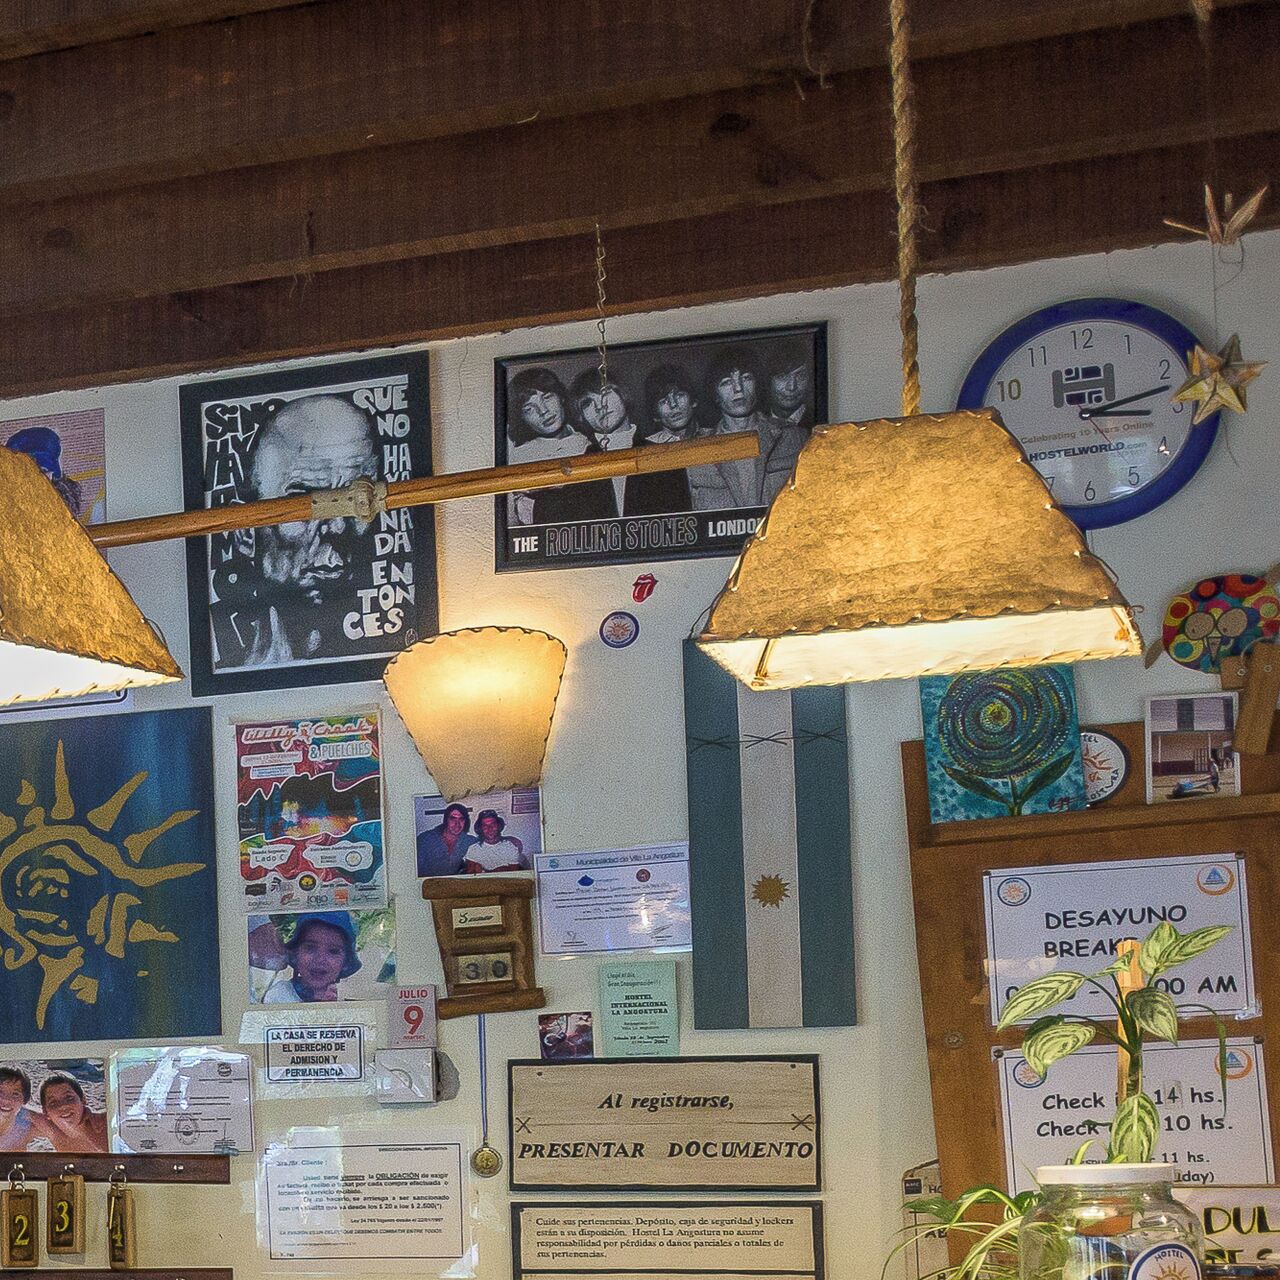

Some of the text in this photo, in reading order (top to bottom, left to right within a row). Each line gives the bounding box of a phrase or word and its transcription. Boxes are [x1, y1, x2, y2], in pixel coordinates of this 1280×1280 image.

[1071, 328, 1093, 349] 12
[1124, 335, 1131, 354] 1
[1028, 346, 1047, 367] 11
[1159, 359, 1170, 380] 2
[353, 385, 408, 415] QUE
[997, 379, 1021, 401] 10
[377, 414, 410, 437] NO
[513, 516, 761, 556] THE ROLLING STONES LONDO
[1045, 905, 1187, 930] DESAYUNO
[399, 990, 428, 999] JULIO
[1198, 975, 1237, 994] AM
[403, 1005, 424, 1035] 9
[271, 1030, 357, 1040] LA CASA SE RESERVA
[597, 1093, 734, 1112] Al registrarse,
[1042, 1087, 1222, 1110] Check 14 hs.
[1036, 1114, 1233, 1137] Check 10 hs.
[518, 1141, 814, 1159] PRESENTAR DOCUMENTO
[56, 1200, 70, 1233] 3
[536, 1218, 561, 1226] Cuide
[14, 1214, 30, 1246] 2
